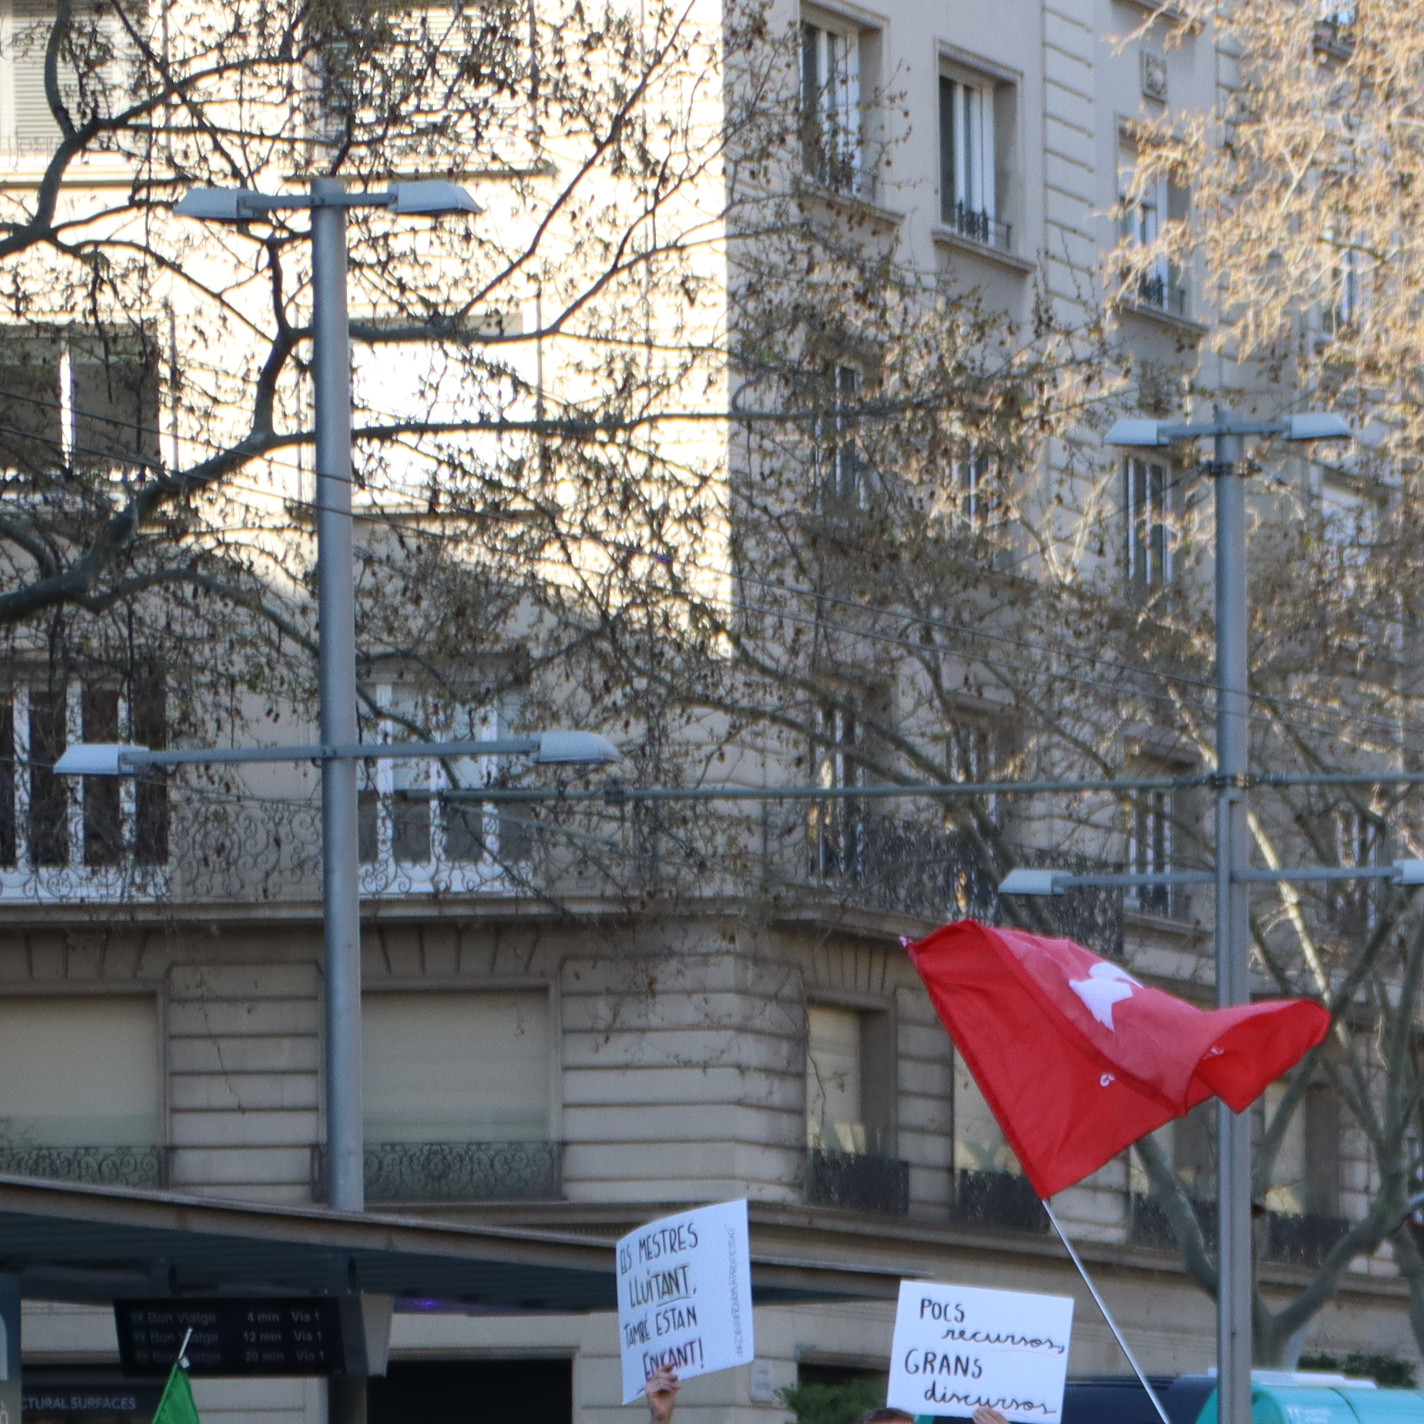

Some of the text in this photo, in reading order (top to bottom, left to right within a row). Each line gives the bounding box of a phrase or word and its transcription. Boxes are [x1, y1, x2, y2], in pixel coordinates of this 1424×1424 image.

[620, 1222, 698, 1276] ELS MESTRES
[148, 1312, 171, 1323] Bon
[177, 1311, 216, 1327] Viatge
[258, 1312, 279, 1323] min
[291, 1312, 310, 1322] Via
[919, 1299, 965, 1323] POCS
[243, 1332, 256, 1343] 12
[260, 1332, 282, 1343] min
[294, 1331, 313, 1343] Via
[624, 1306, 698, 1350] TAMBÉ ESTAN
[941, 1327, 1065, 1354] recursos,
[261, 1353, 284, 1363] min
[904, 1348, 983, 1379] GRANS
[71, 1397, 137, 1411] SURFACES
[924, 1380, 1057, 1414] discursos
